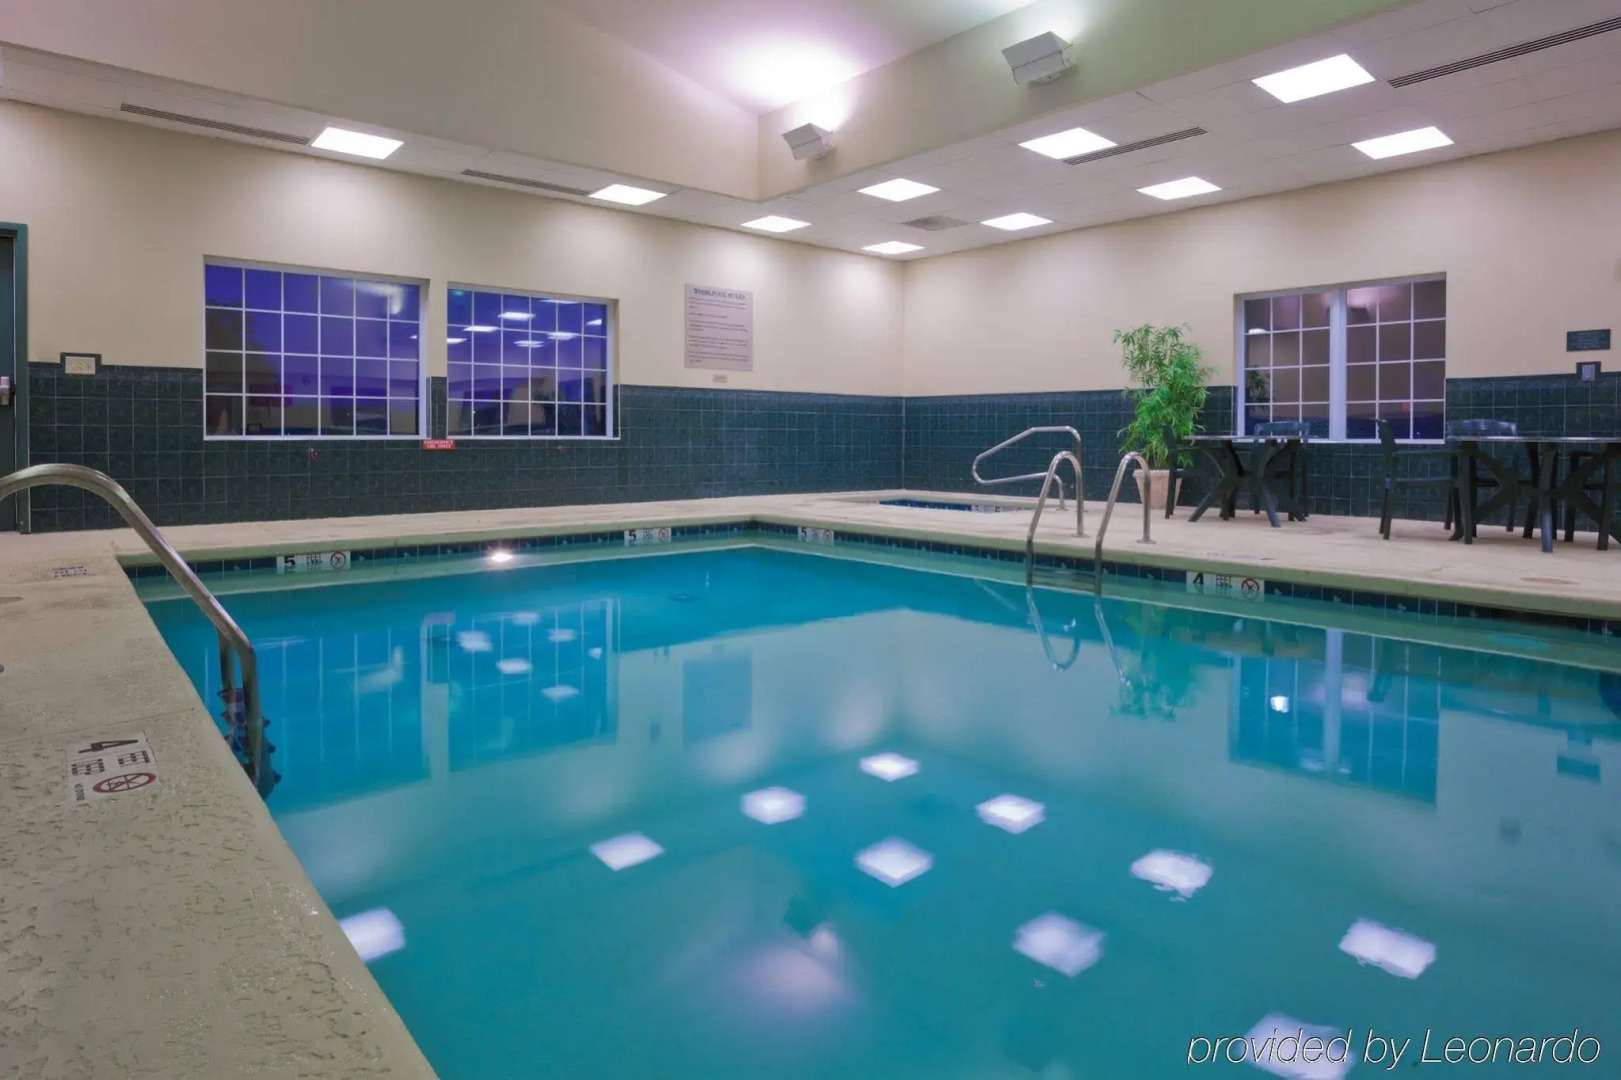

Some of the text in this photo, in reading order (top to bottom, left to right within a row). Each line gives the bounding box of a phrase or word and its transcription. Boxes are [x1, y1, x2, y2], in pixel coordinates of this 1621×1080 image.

[629, 529, 637, 541] 5
[284, 555, 296, 568] 5
[78, 739, 139, 754] 4
